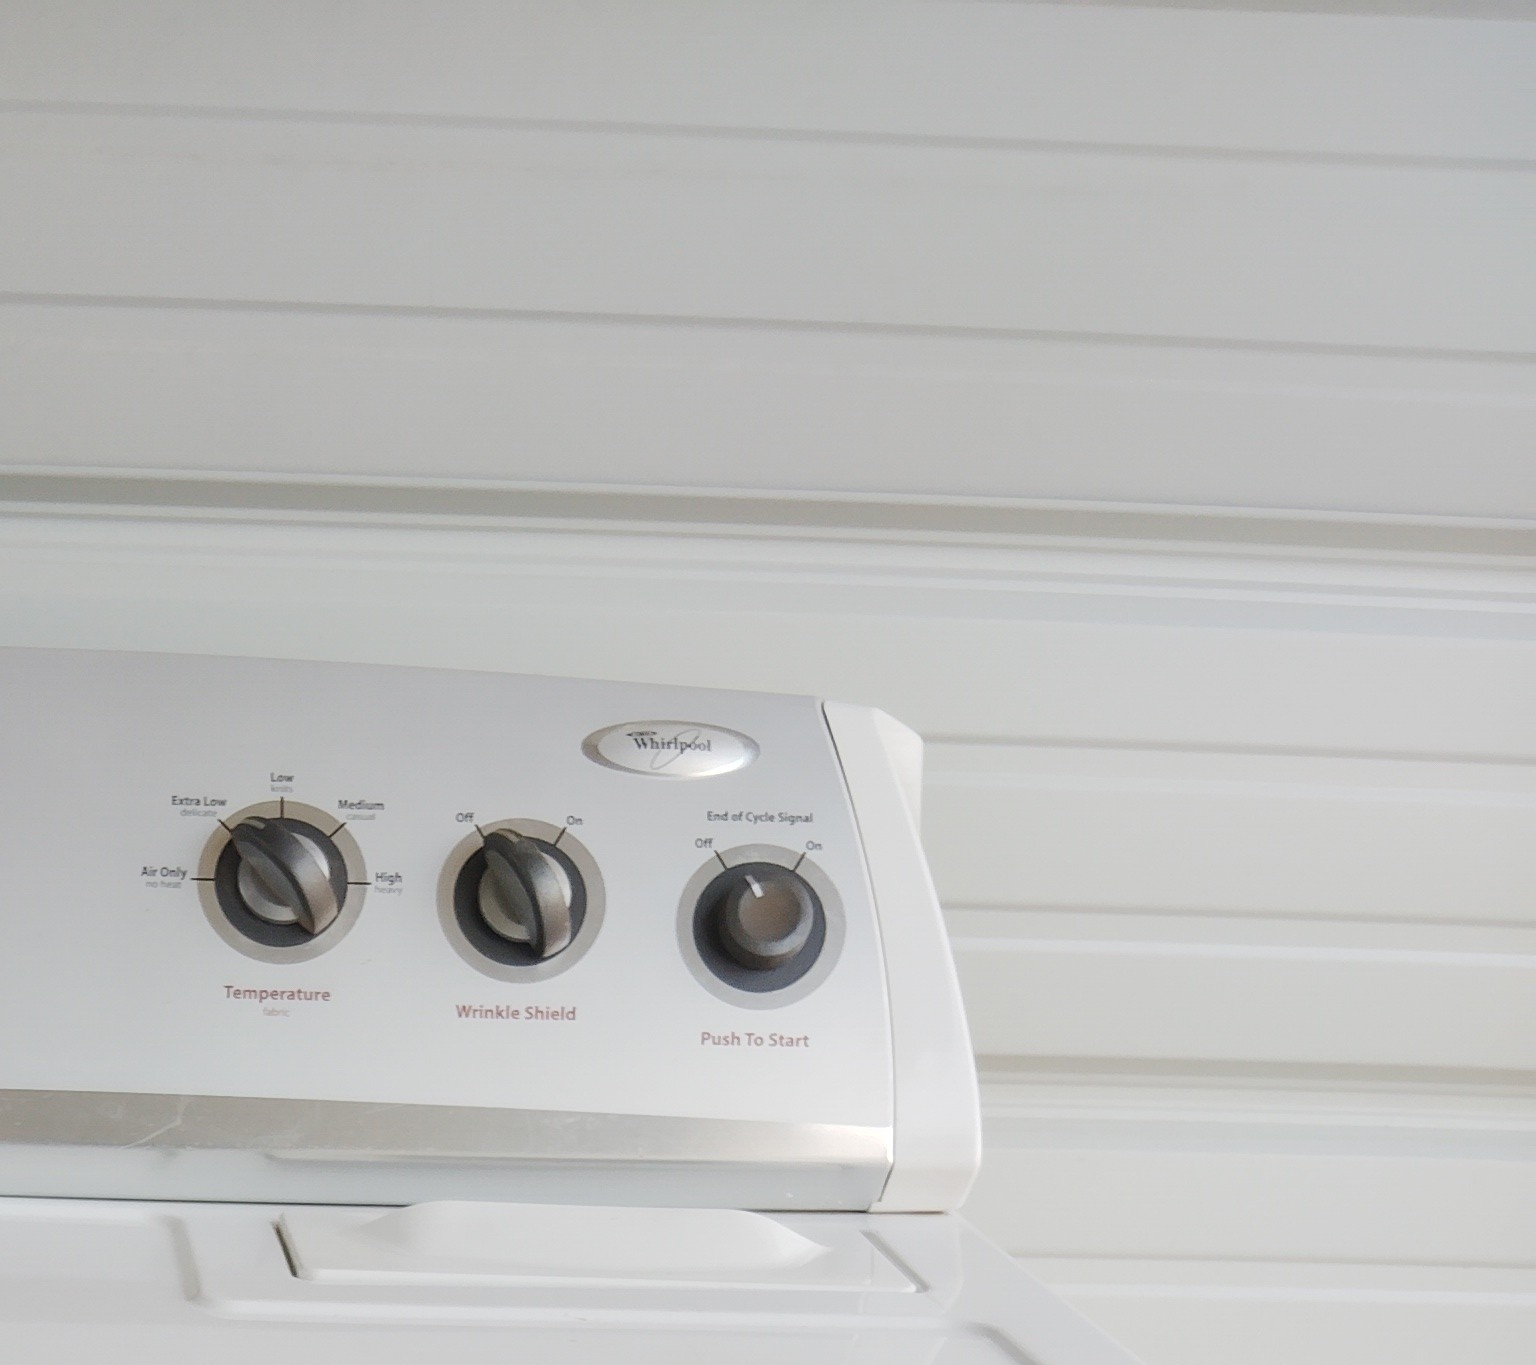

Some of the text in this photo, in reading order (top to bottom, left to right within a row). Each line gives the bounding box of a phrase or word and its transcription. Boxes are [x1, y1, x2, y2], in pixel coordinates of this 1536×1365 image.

[633, 737, 713, 754] Whirlpool
[270, 772, 294, 783] Low
[171, 795, 227, 807] Extra Low
[338, 800, 385, 811] Medium
[455, 813, 475, 823] Off
[566, 816, 583, 826] On
[707, 812, 813, 825] End of Cycle Signal
[695, 838, 713, 849] Off
[805, 841, 822, 852] On
[141, 867, 188, 880] Air Only
[375, 872, 402, 885] High
[224, 985, 331, 1003] Temperature
[455, 1004, 576, 1021] Wrinkle Shield
[700, 1031, 810, 1048] Push To Start
